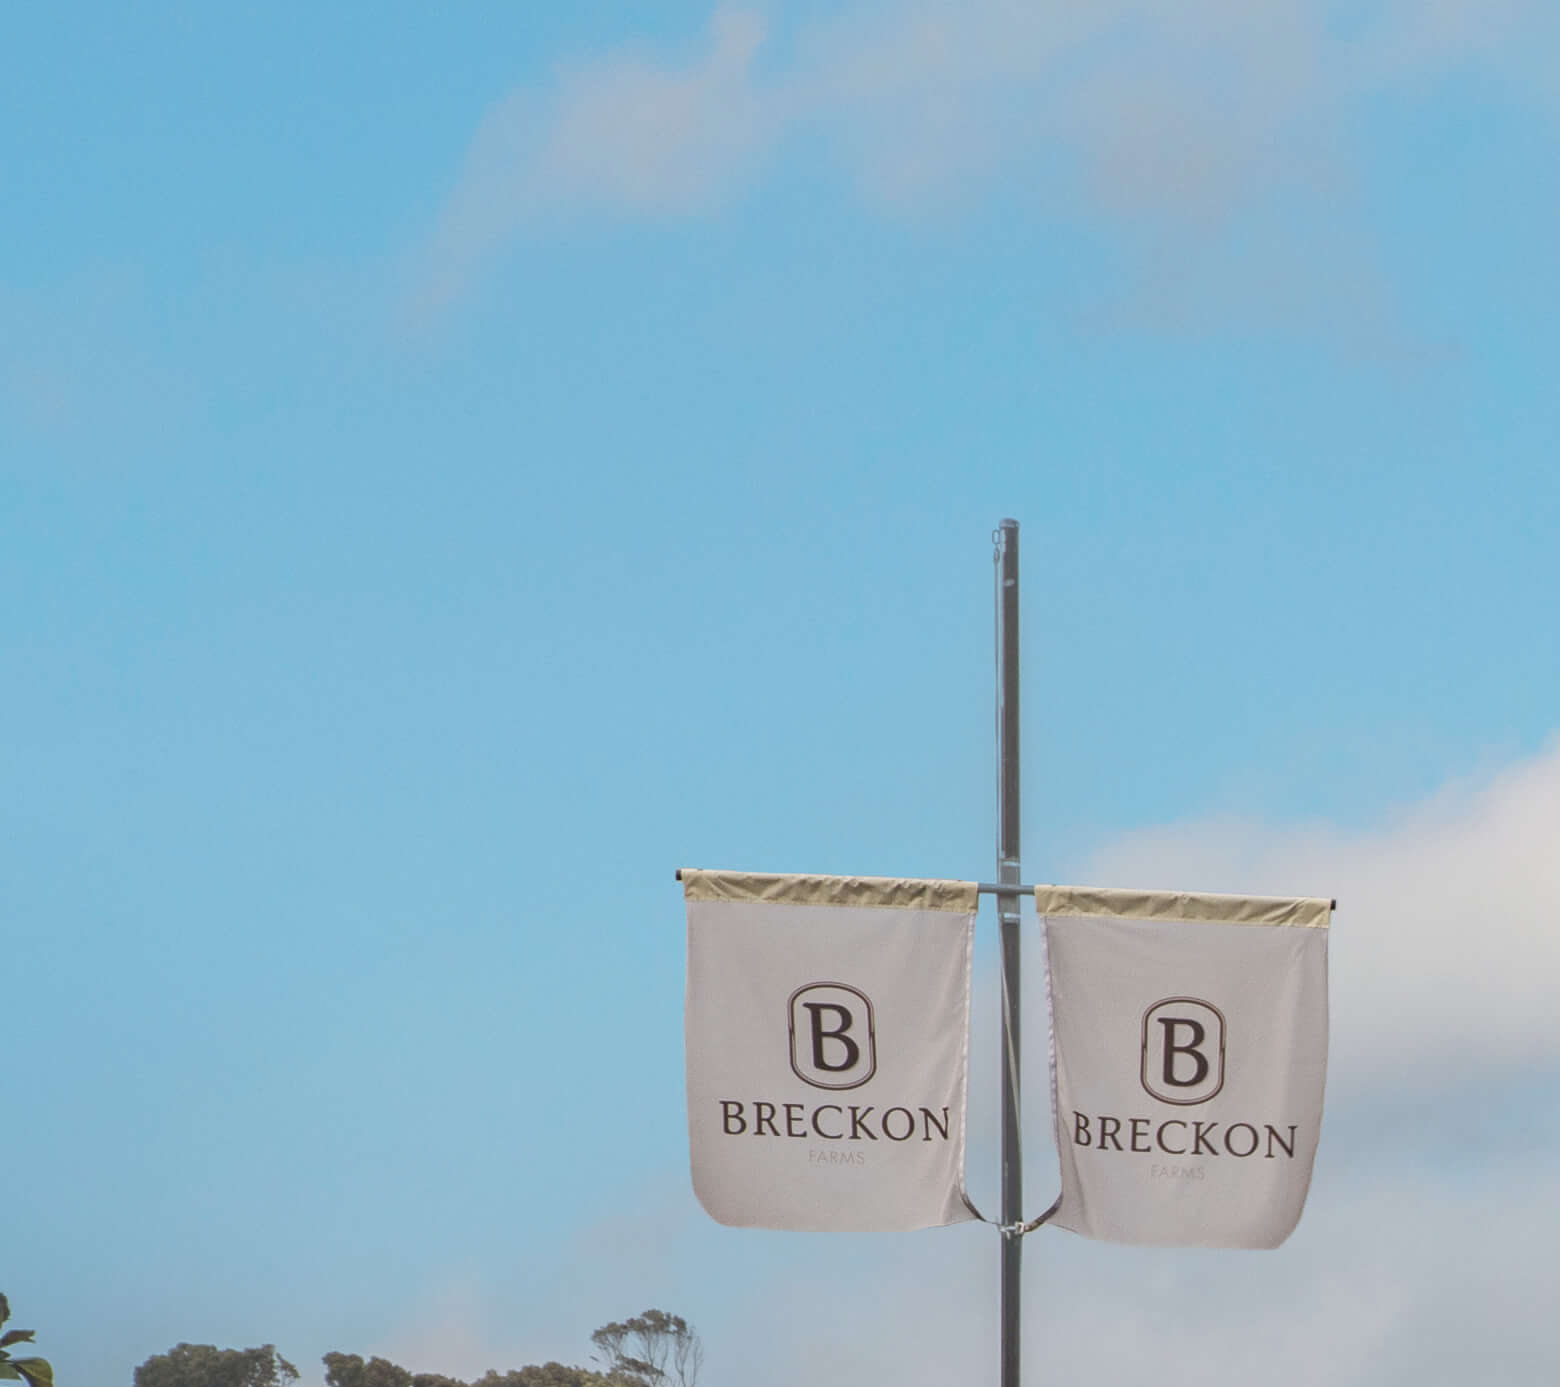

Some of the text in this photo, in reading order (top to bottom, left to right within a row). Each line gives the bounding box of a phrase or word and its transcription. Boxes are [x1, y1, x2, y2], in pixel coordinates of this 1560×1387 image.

[803, 1001, 860, 1072] B
[1156, 1016, 1210, 1088] B
[719, 1100, 950, 1142] BRECKON
[1073, 1111, 1297, 1159] BRECKON
[808, 1149, 866, 1166] FARMS
[1150, 1164, 1205, 1181] FARMS
